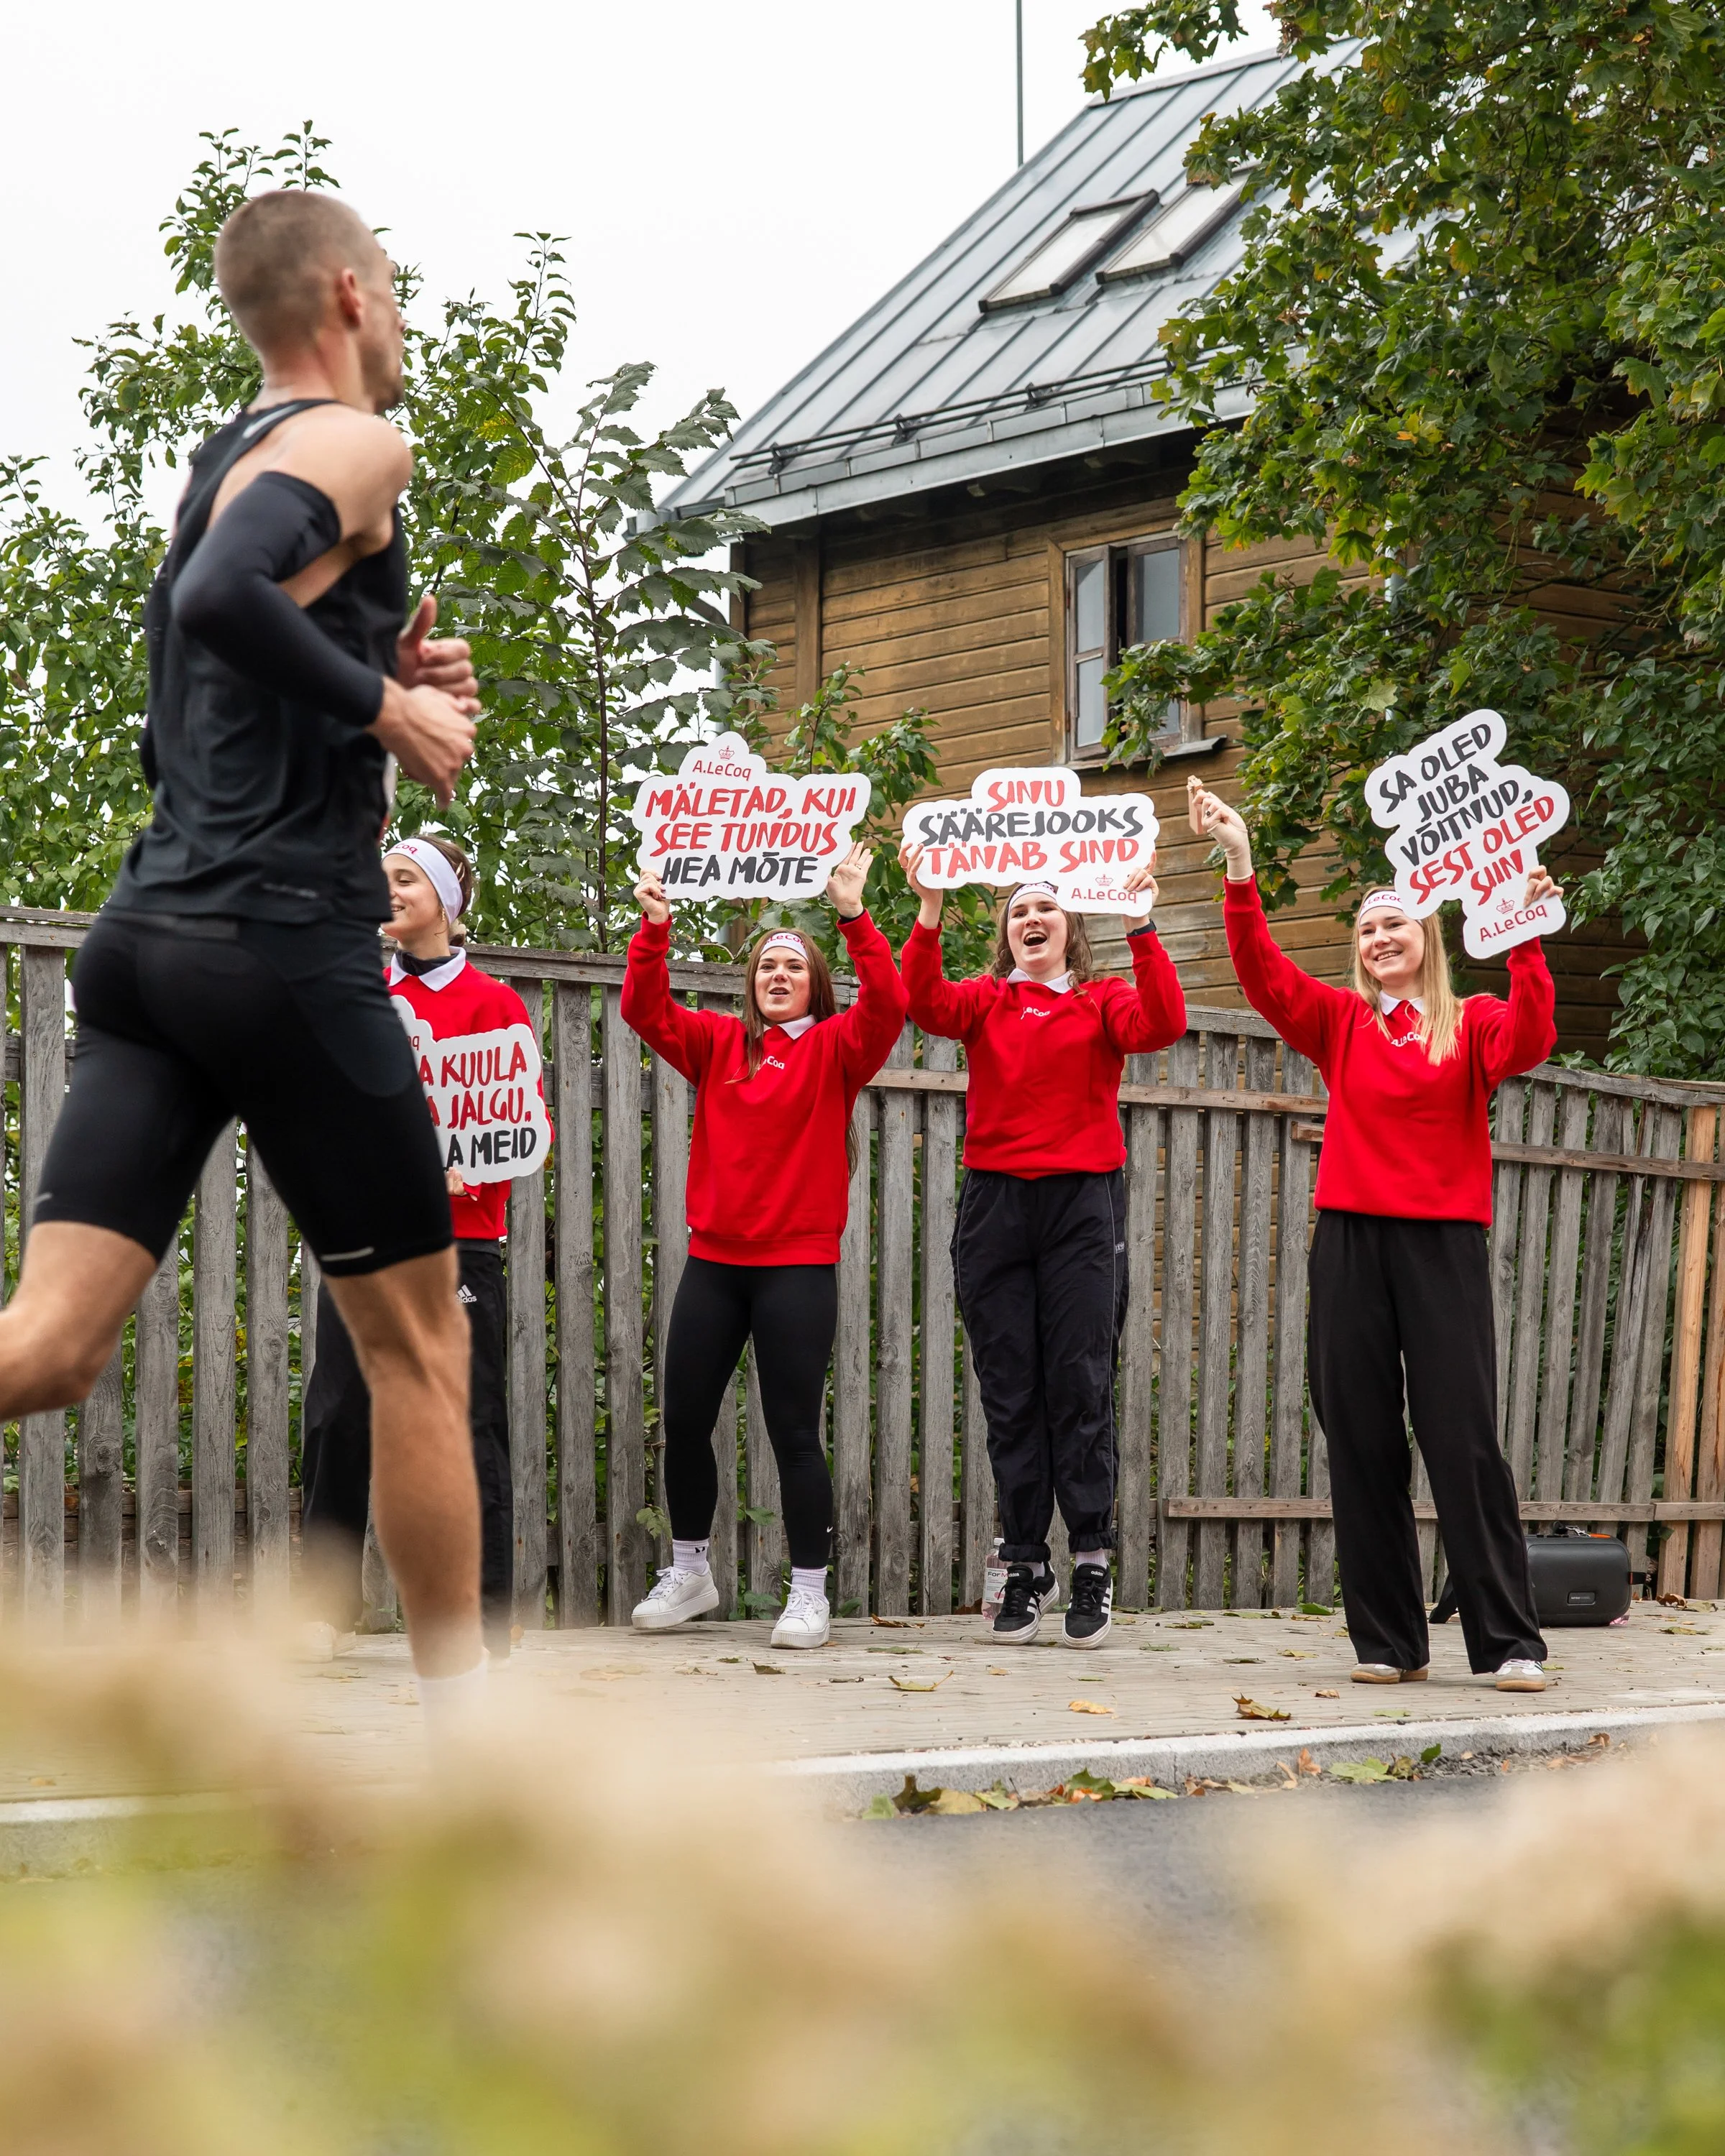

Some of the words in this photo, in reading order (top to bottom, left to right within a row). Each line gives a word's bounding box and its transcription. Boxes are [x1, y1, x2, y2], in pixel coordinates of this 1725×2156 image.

[1379, 770, 1417, 814] SA
[1420, 724, 1491, 781] OLED
[645, 782, 794, 821] MÄLETAD,
[801, 787, 857, 819] KUI
[986, 780, 1065, 812] SINU
[1416, 763, 1489, 823] JUBA
[649, 822, 713, 857] SEE
[720, 821, 839, 856] TUNDUS
[919, 806, 1144, 847] SÄÄREJOOKS
[1399, 780, 1534, 867] VÕITNUD,
[661, 854, 722, 888] HEA
[727, 851, 819, 886] MÕTE
[925, 842, 1048, 878] TÄNAB
[1059, 838, 1140, 873] SIND
[1409, 842, 1474, 905] SEST
[1483, 796, 1555, 854] OLED
[1470, 849, 1523, 906] SIIN
[441, 1041, 527, 1088] KUULA
[447, 1087, 532, 1130] JALGU.
[470, 1127, 537, 1169] MEID
